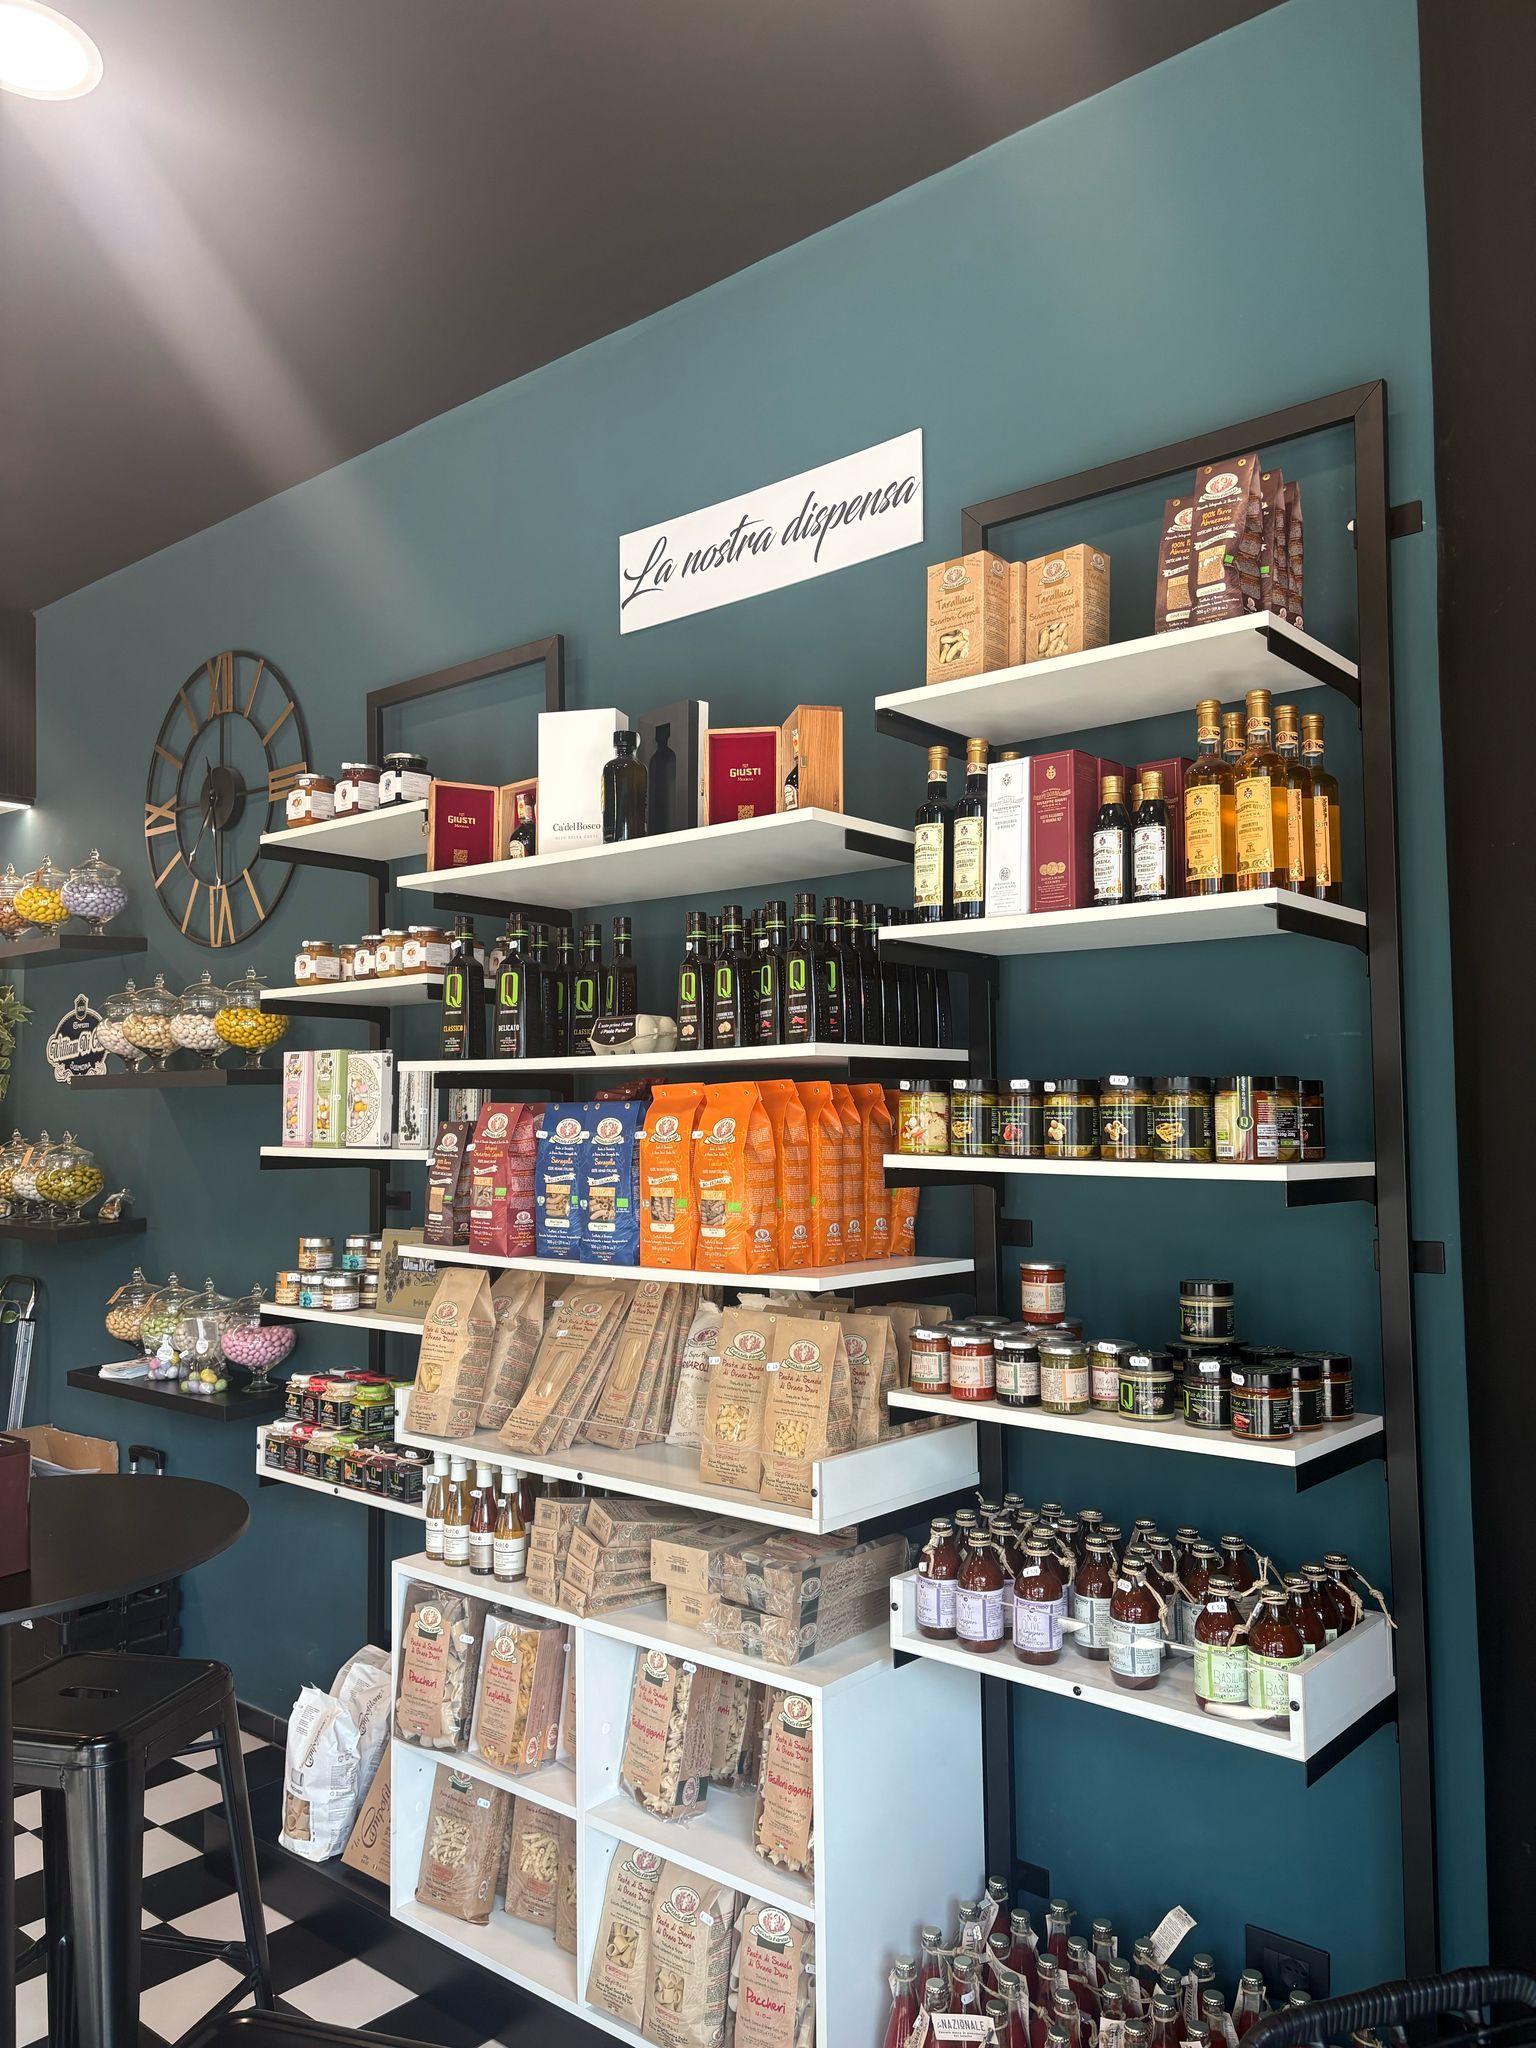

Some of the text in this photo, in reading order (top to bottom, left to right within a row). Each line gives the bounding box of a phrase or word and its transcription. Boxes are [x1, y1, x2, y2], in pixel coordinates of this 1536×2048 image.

[621, 476, 920, 609] La nostra dispensa
[730, 767, 761, 778] GIUSTI
[447, 815, 476, 825] GIUSTI
[443, 1025, 464, 1033] CLASSICO
[498, 1024, 520, 1033] DELICATO
[722, 1359, 764, 1371] Pasta di Semola
[730, 1369, 747, 1378] Grano
[778, 1371, 822, 1385] Pasta di Semola
[786, 1381, 803, 1391] Grano
[1121, 1382, 1134, 1410] Q
[617, 1872, 655, 1896] Pasta di Semola
[617, 1884, 651, 1905] di Grano Duro
[655, 1914, 696, 1940] Pasta di Semola
[656, 1928, 692, 1950] di Grano Duro
[746, 1946, 792, 1971] Pasta di Semola
[748, 1960, 789, 1980] di Grano Duro
[746, 1986, 787, 2015] Paccheri
[941, 2018, 986, 2032] NAZIONALE
